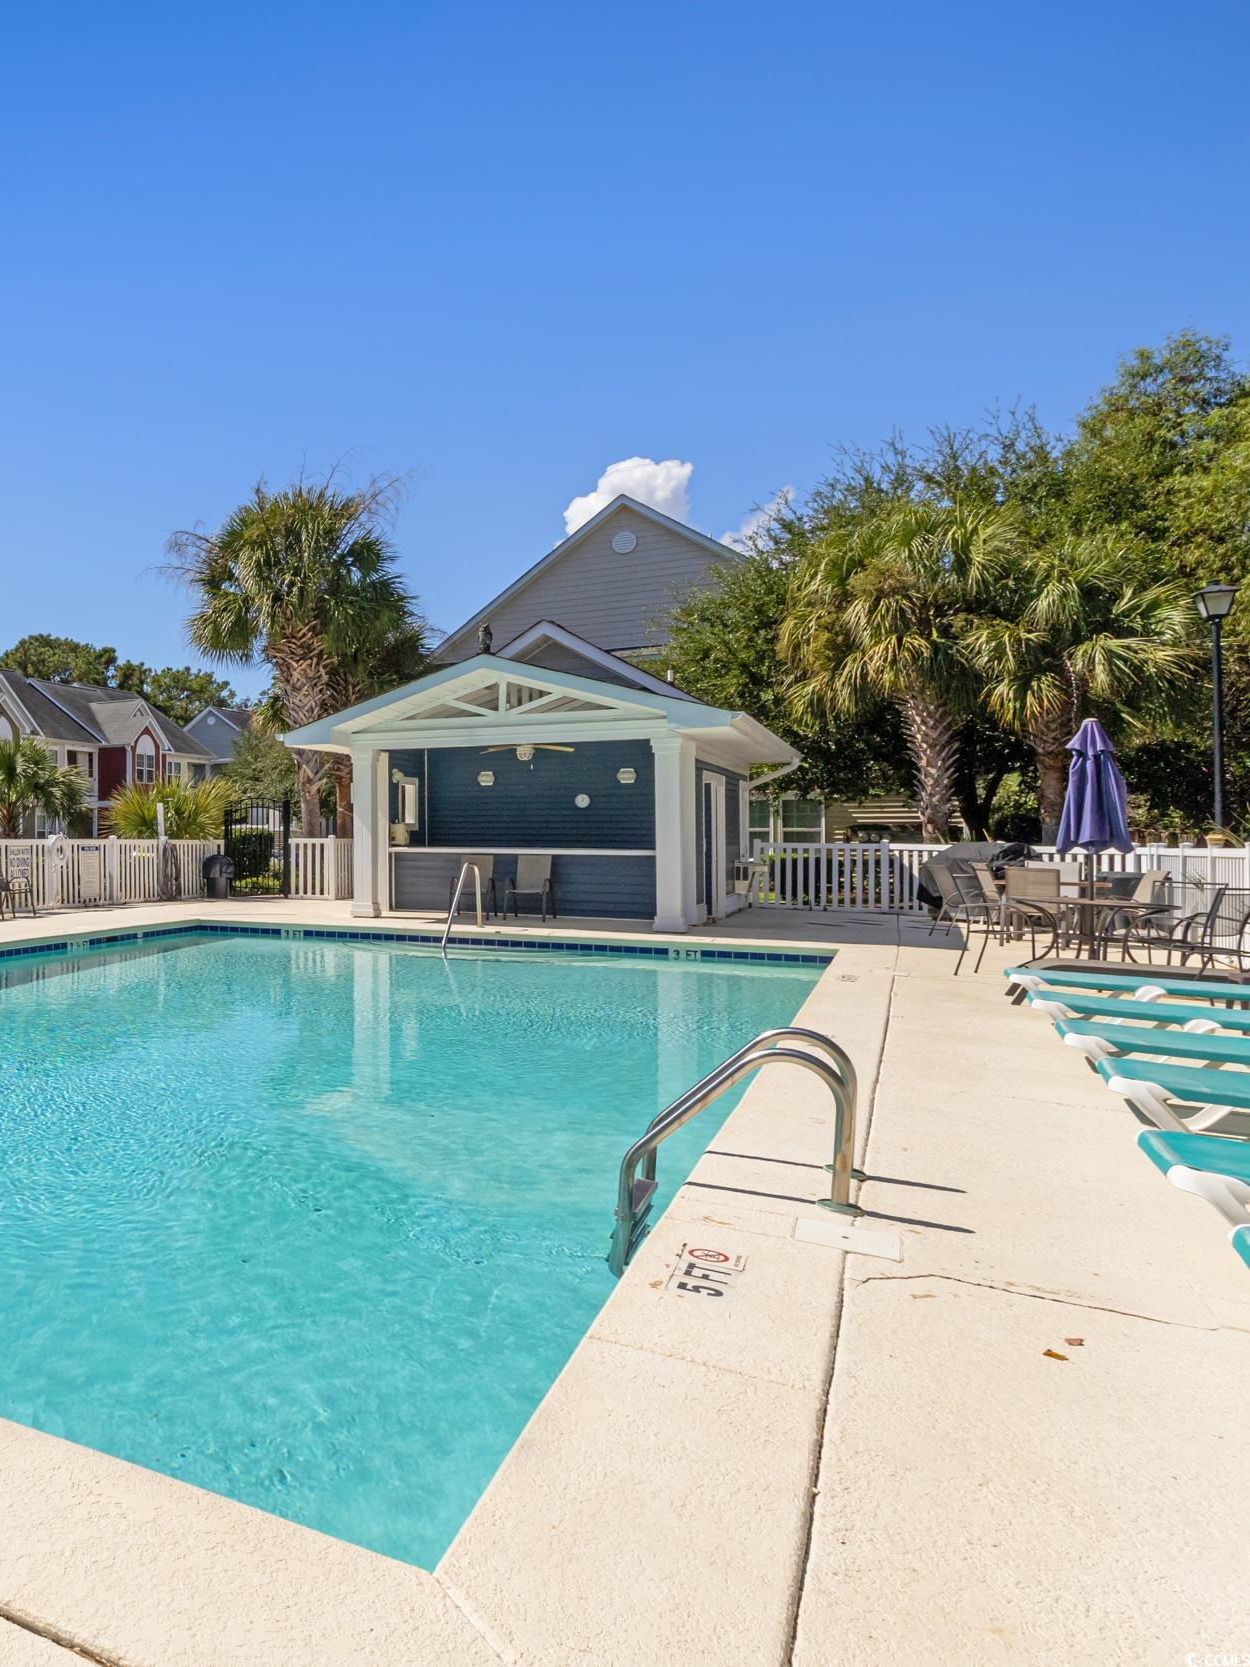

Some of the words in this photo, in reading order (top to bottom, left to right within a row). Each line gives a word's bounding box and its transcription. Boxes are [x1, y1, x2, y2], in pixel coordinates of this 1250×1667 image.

[9, 857, 15, 867] NO
[16, 856, 30, 867] DIVING
[673, 949, 680, 960] 3
[686, 950, 699, 961] FT
[683, 1262, 732, 1285] FT
[676, 1281, 724, 1297] 5
